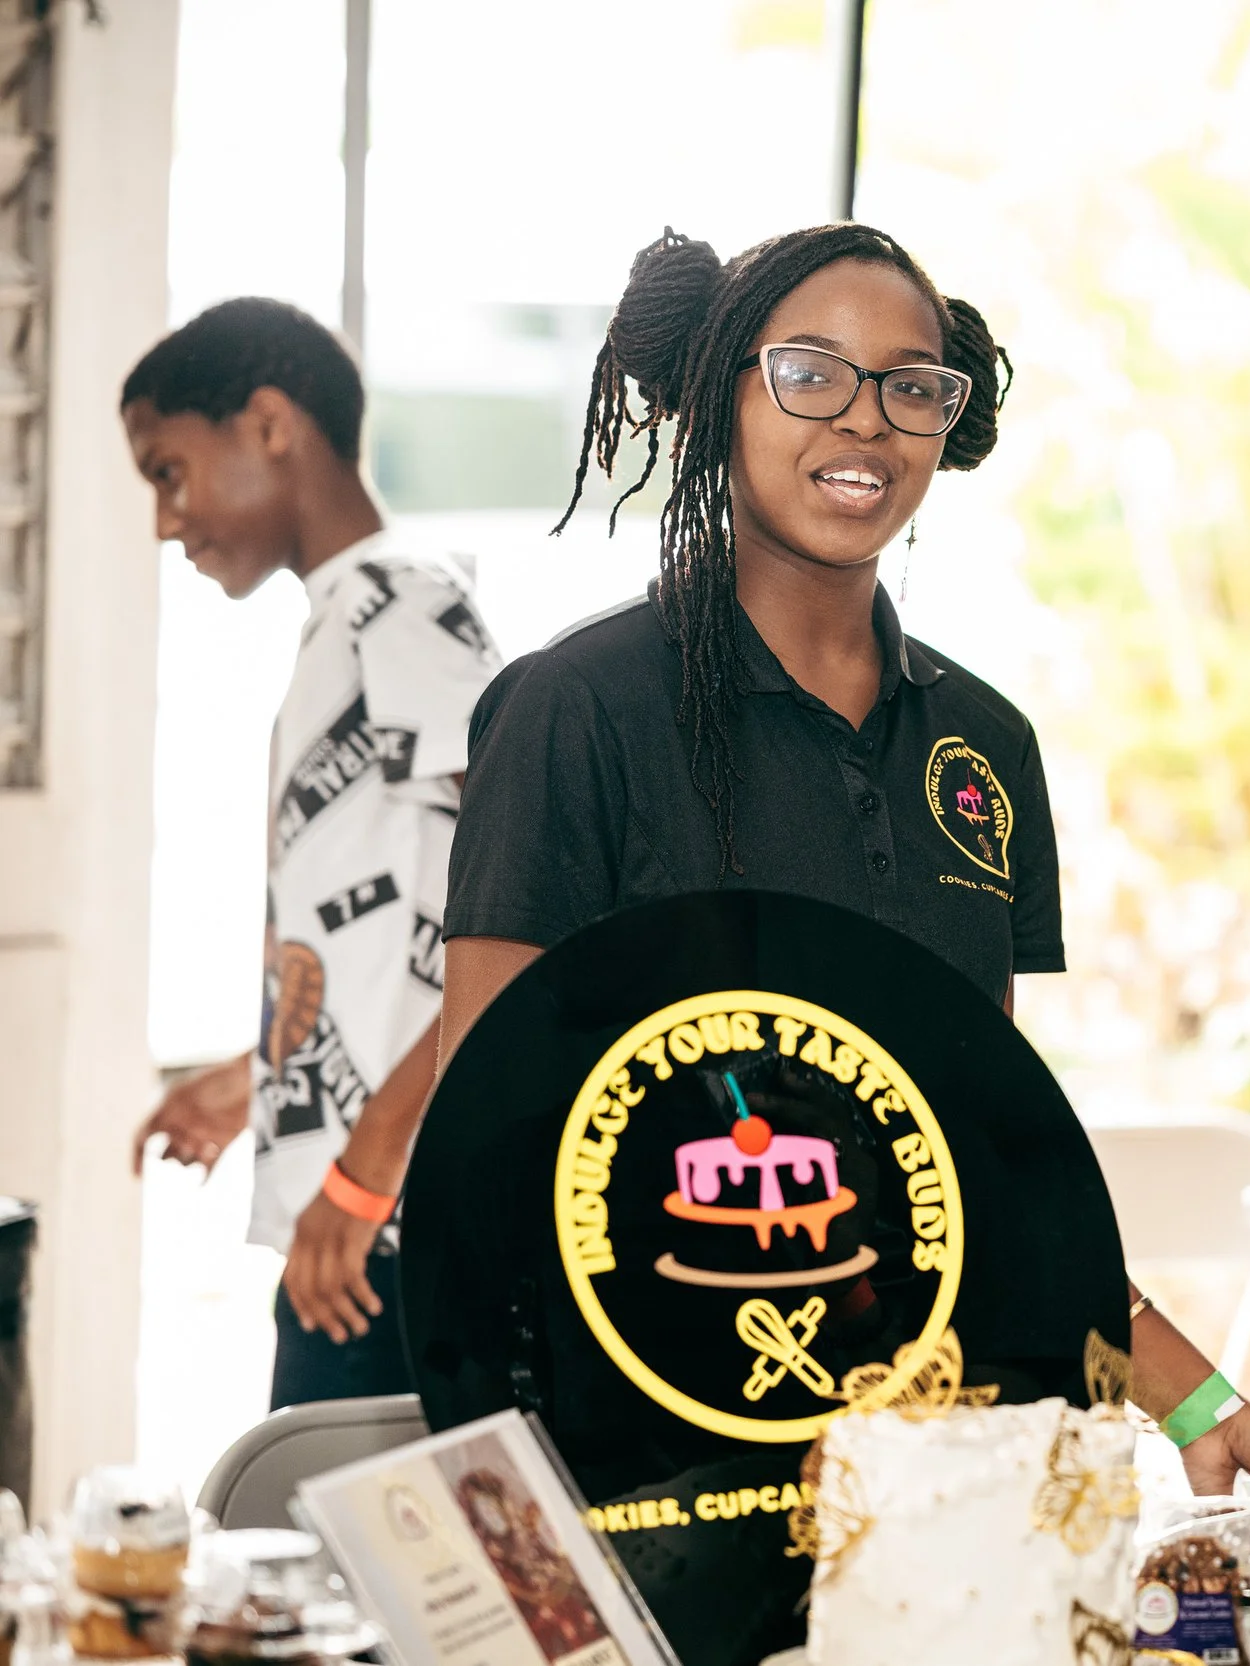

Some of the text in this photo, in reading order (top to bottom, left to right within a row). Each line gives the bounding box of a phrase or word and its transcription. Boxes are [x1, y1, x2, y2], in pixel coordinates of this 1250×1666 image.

[990, 798, 1007, 840] BUDS
[574, 1011, 949, 1275] INDULGE YOUR TASTE BUDS
